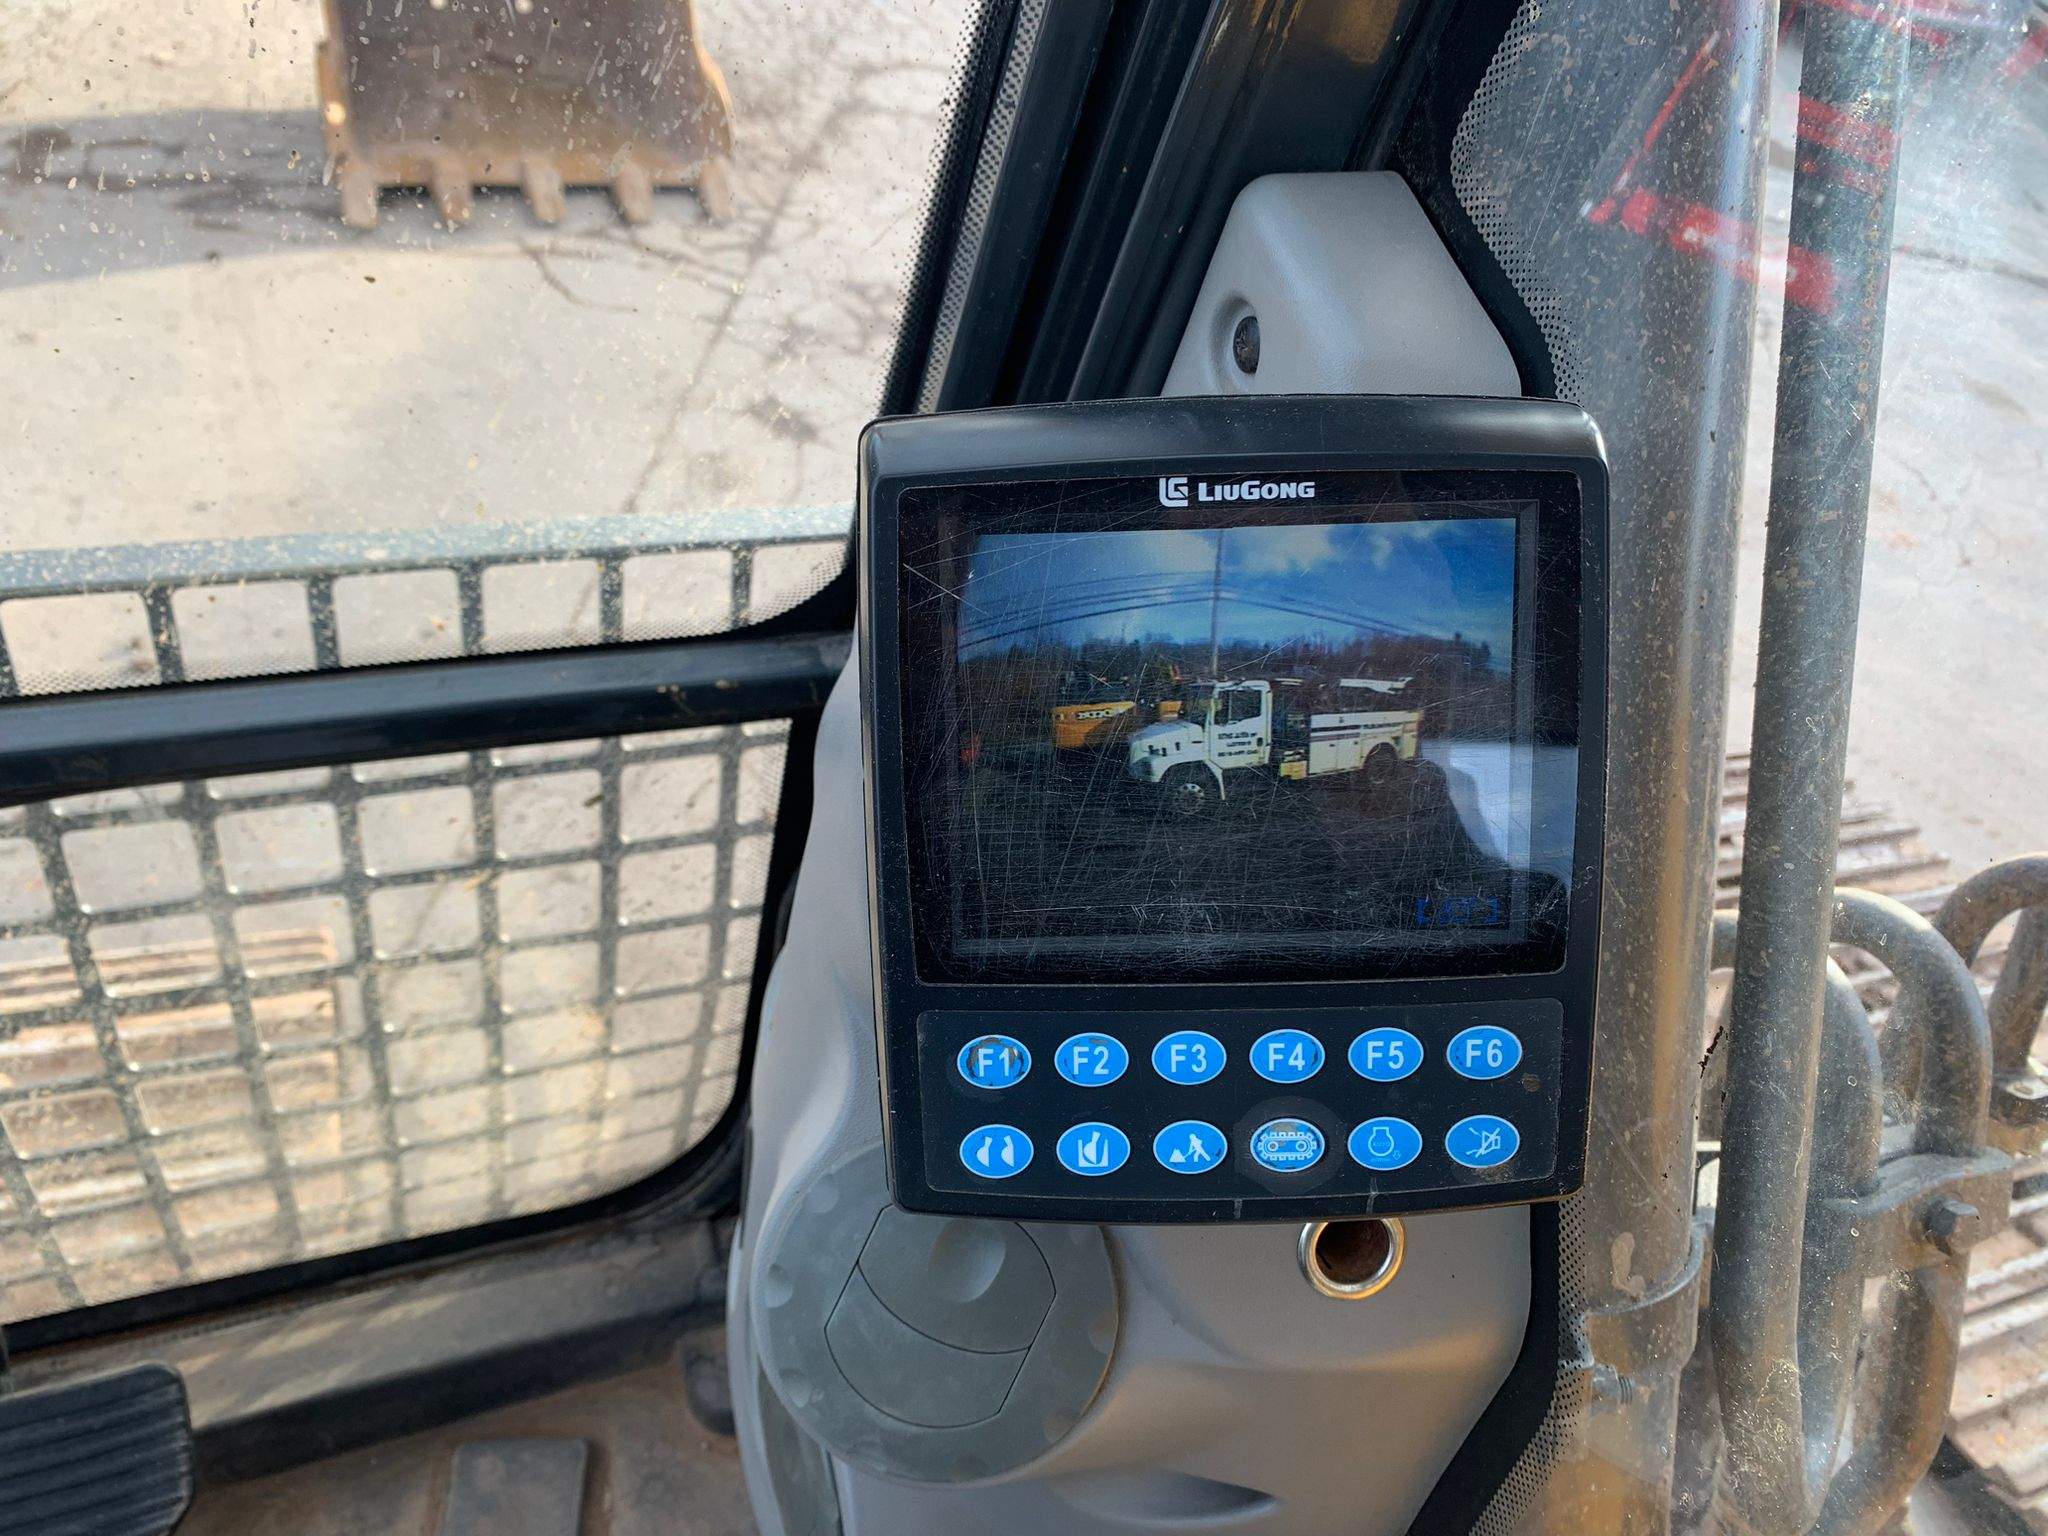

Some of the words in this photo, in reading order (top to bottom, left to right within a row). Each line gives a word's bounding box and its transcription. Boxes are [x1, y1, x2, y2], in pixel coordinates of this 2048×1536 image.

[978, 1048, 1011, 1077] F1
[1073, 1046, 1109, 1075] F2
[1170, 1044, 1207, 1073] F3
[1268, 1042, 1305, 1071] F4
[1367, 1041, 1404, 1069] F5
[1466, 1039, 1503, 1068] F6
